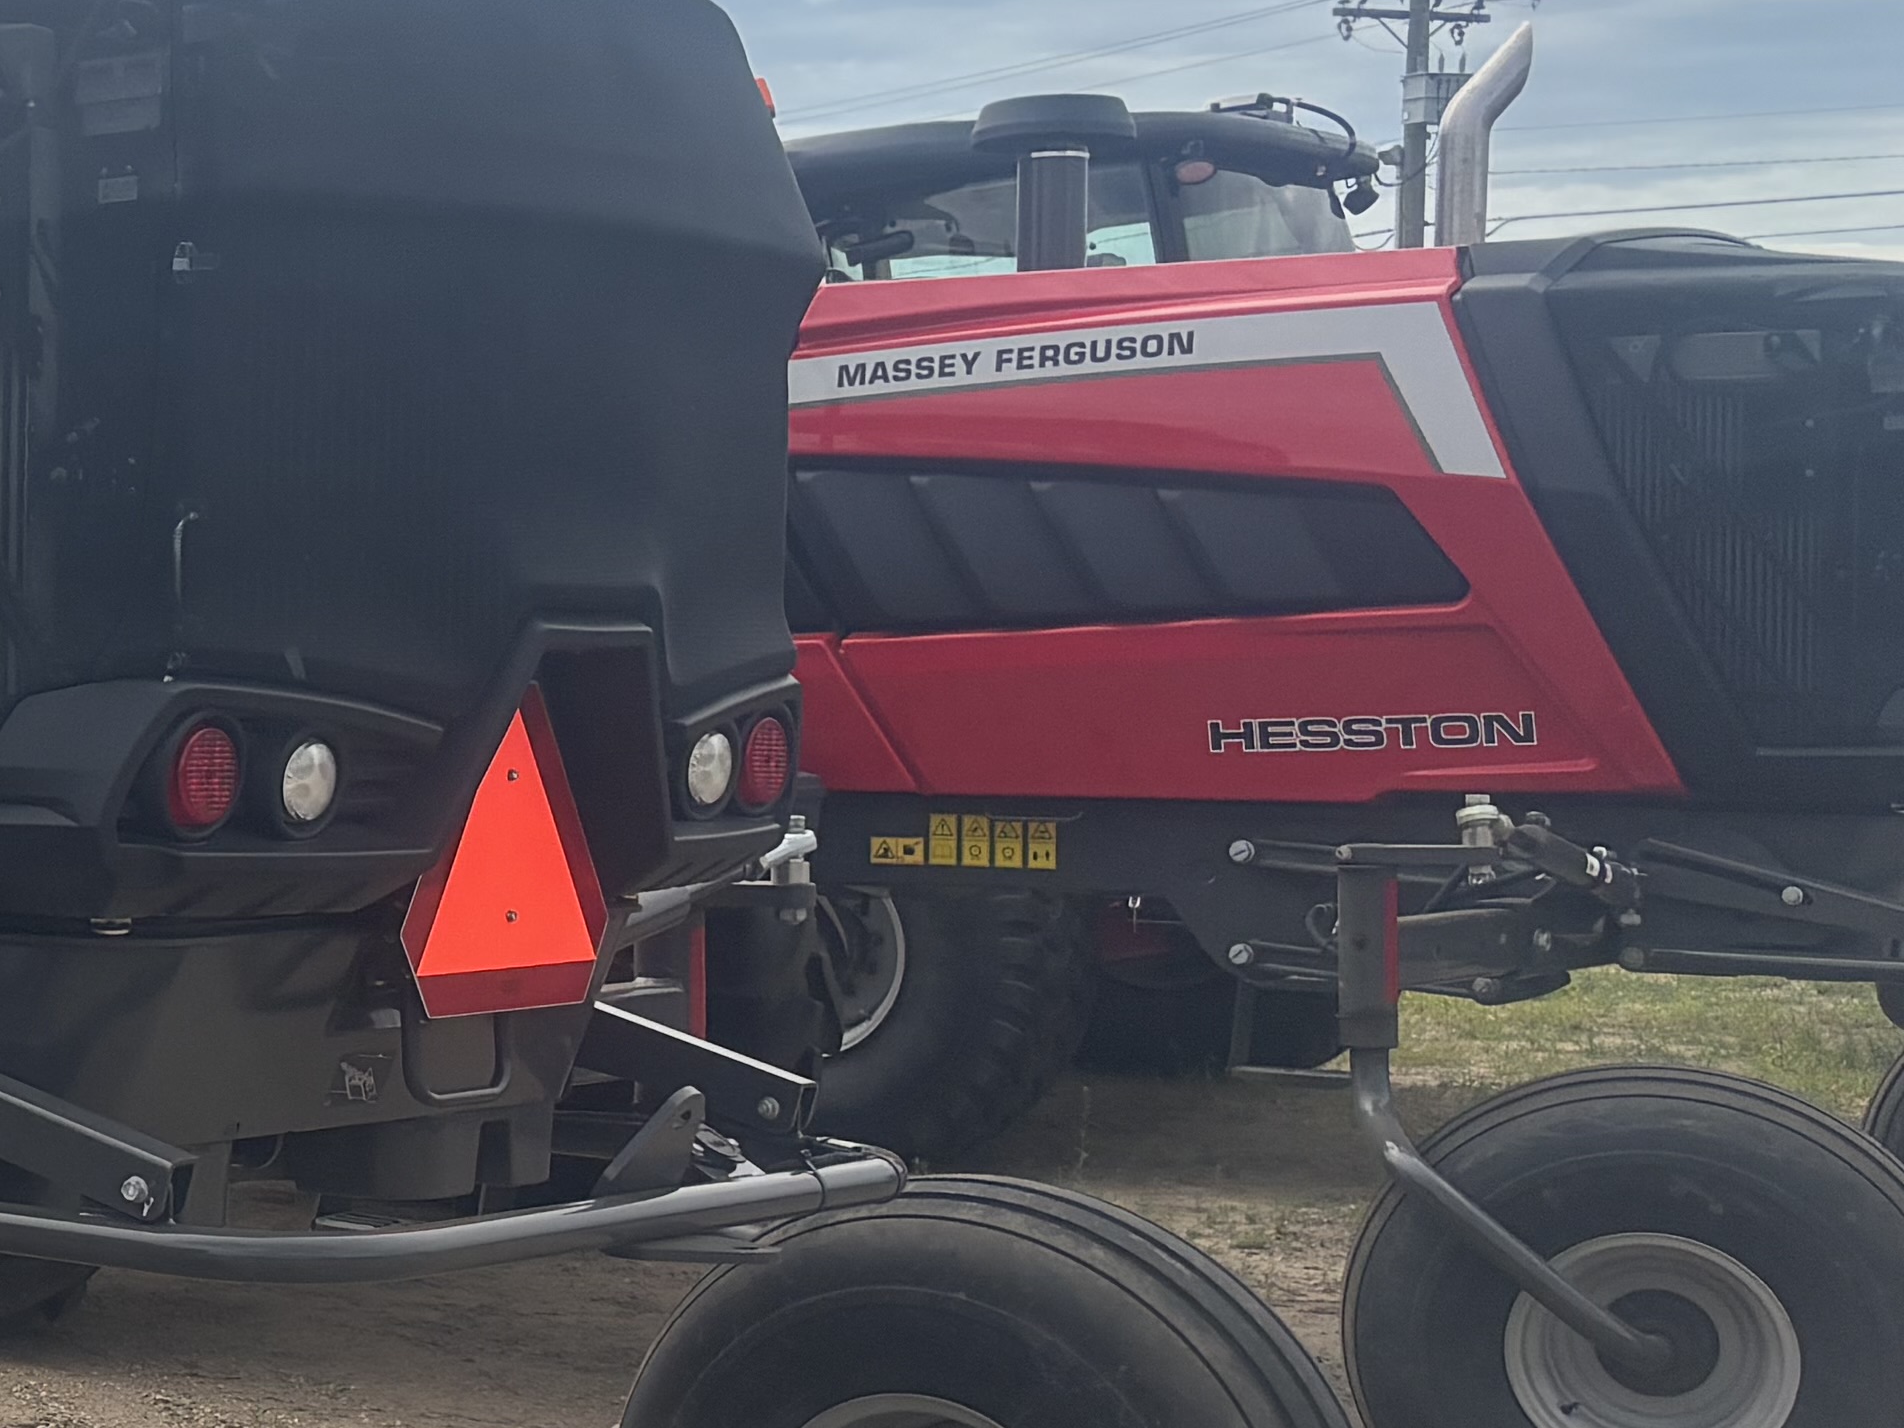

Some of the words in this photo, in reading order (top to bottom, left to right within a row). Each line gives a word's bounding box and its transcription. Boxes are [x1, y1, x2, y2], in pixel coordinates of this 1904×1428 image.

[836, 350, 982, 388] MASSEY
[994, 330, 1195, 373] FERGUSON
[1207, 711, 1538, 753] HESSTON
